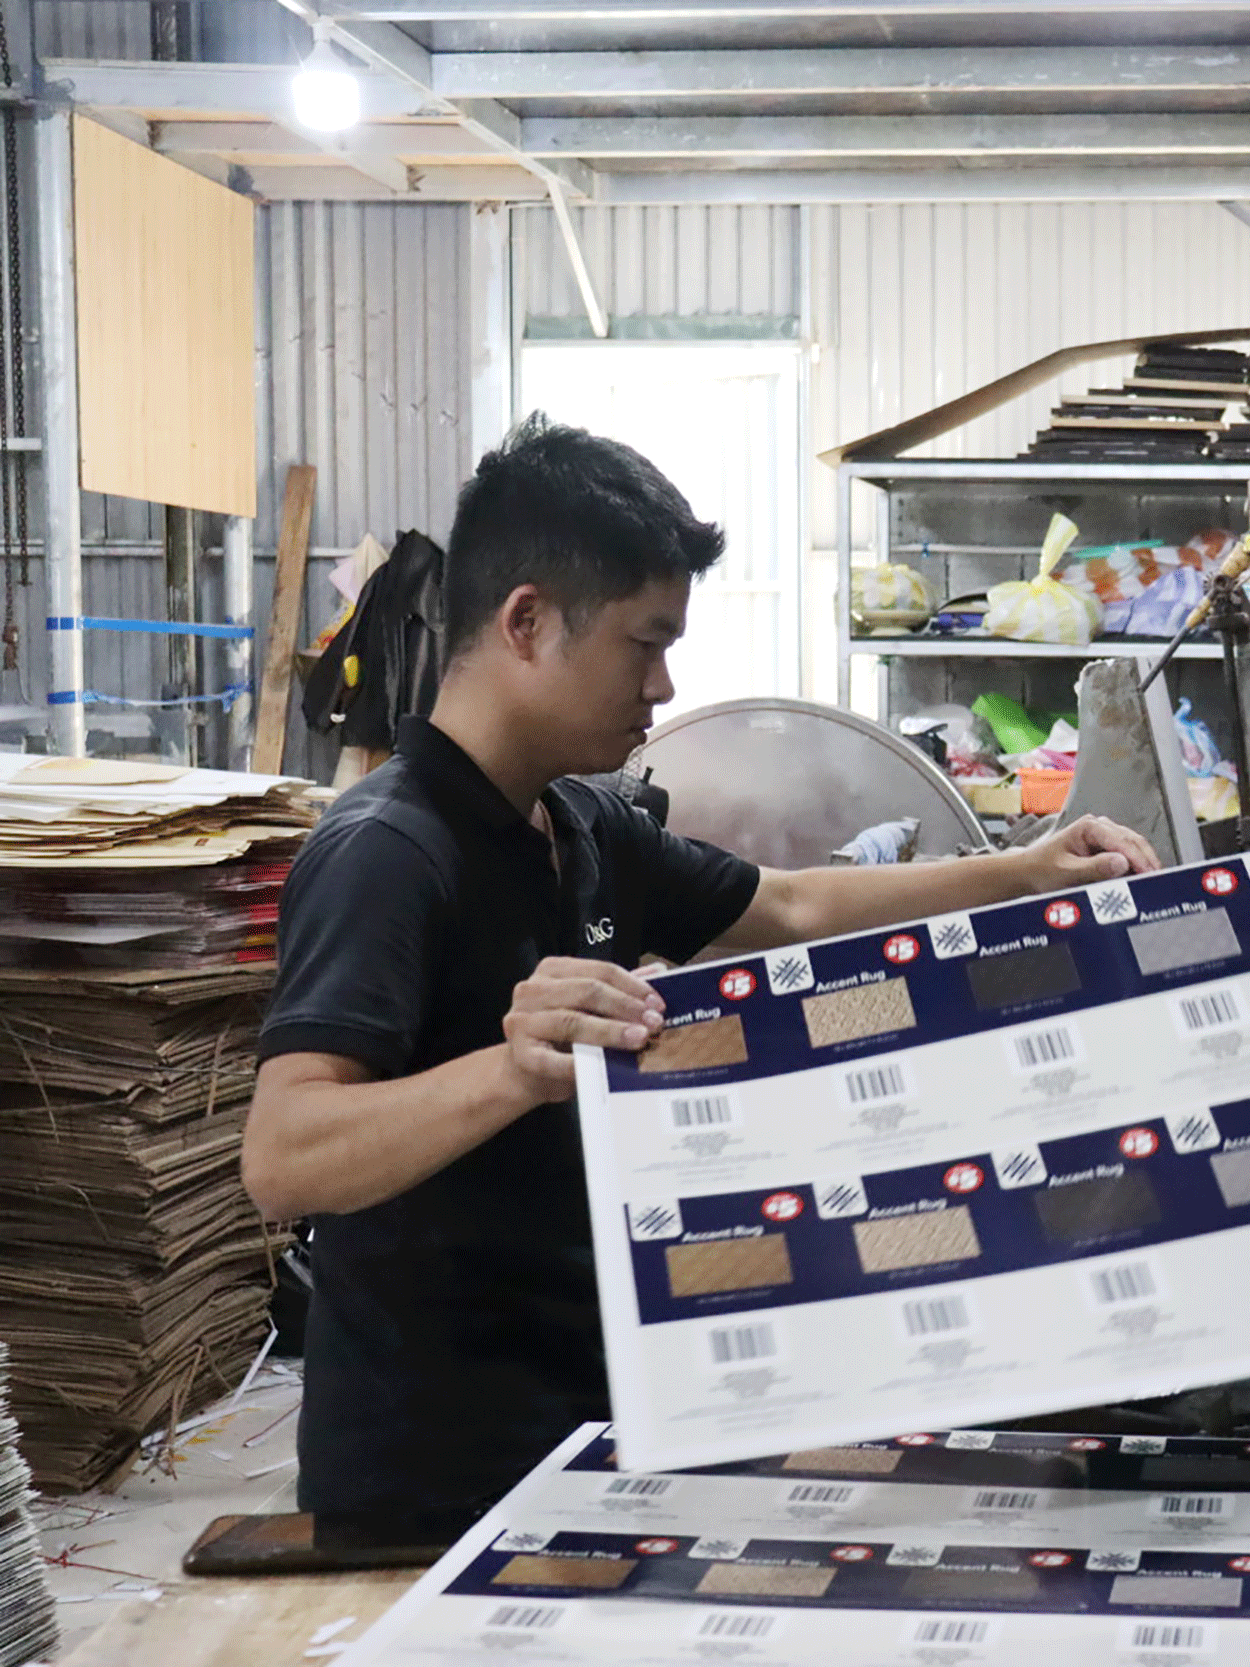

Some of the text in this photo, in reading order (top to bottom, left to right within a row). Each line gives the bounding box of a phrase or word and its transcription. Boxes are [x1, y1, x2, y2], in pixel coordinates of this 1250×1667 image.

[1140, 901, 1207, 922] Accent Rug
[979, 935, 1049, 958] Accent Rug
[816, 970, 887, 993] Accent Rug
[664, 1007, 721, 1027] cent Rug
